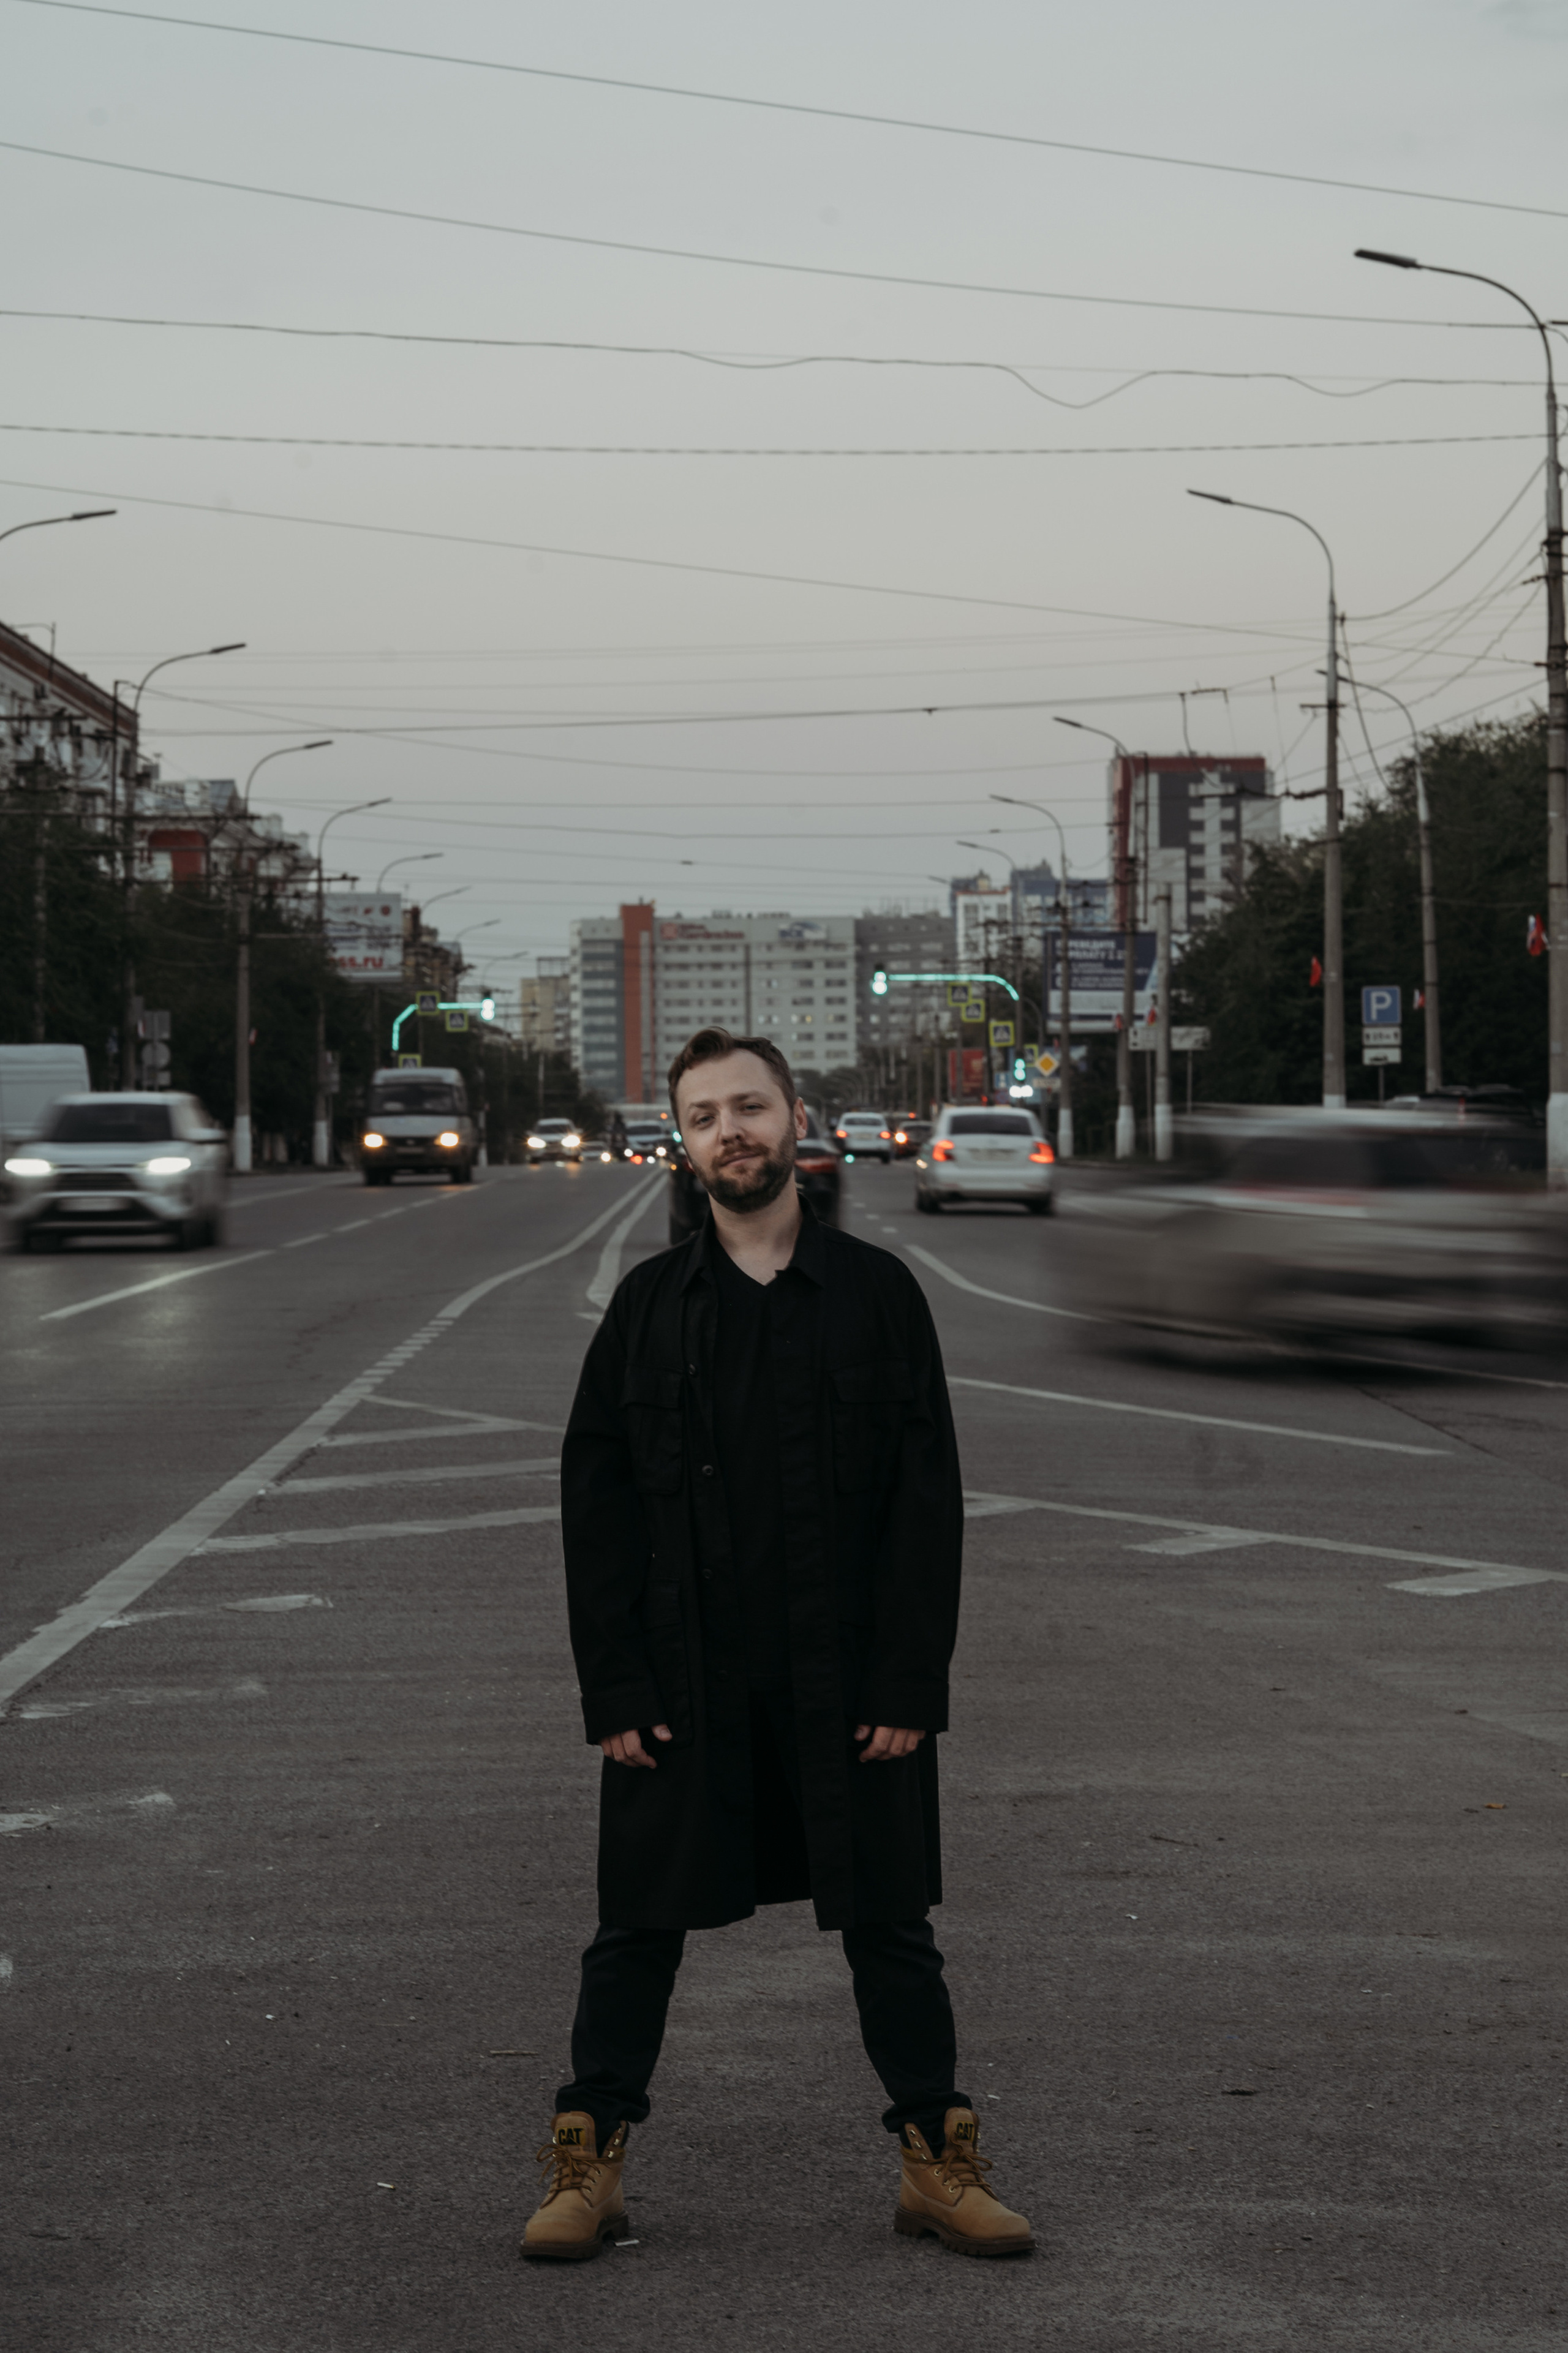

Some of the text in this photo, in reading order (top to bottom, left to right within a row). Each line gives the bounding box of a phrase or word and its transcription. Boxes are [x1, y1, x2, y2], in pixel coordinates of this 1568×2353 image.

[1370, 990, 1392, 1022] P
[559, 2128, 584, 2146] CAT
[957, 2122, 974, 2140] CAT
